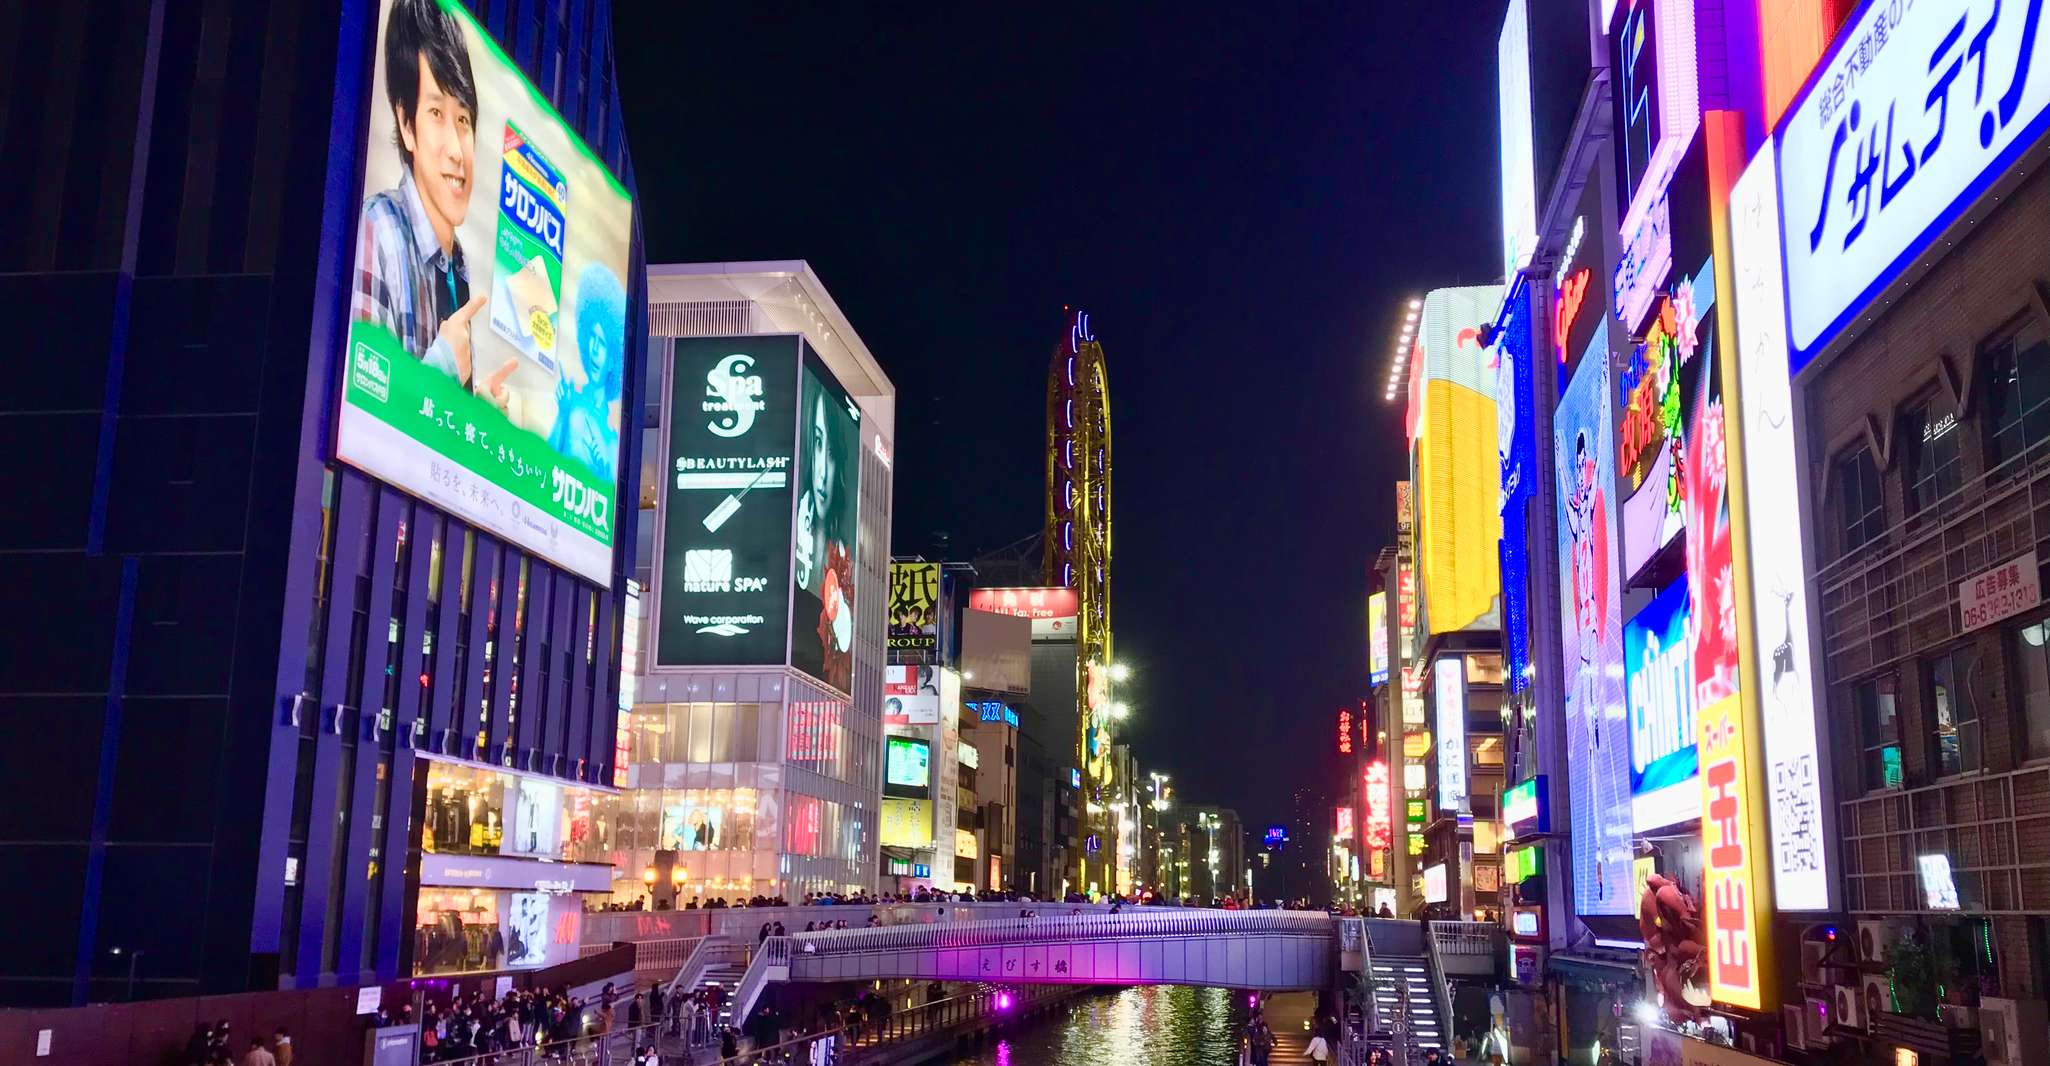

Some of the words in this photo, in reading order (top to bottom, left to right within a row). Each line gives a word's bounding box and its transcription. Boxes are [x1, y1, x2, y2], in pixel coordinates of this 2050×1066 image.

[504, 171, 562, 256] サロンパス
[706, 367, 763, 397] Spa
[702, 400, 766, 412] treatment
[552, 464, 609, 531] サロンパス
[684, 581, 731, 593] nature
[1975, 564, 2020, 600] 広告募集
[684, 615, 709, 624] Wave
[710, 615, 764, 625] corporation
[887, 638, 935, 647] ROUP
[982, 958, 1068, 974] えびす橋
